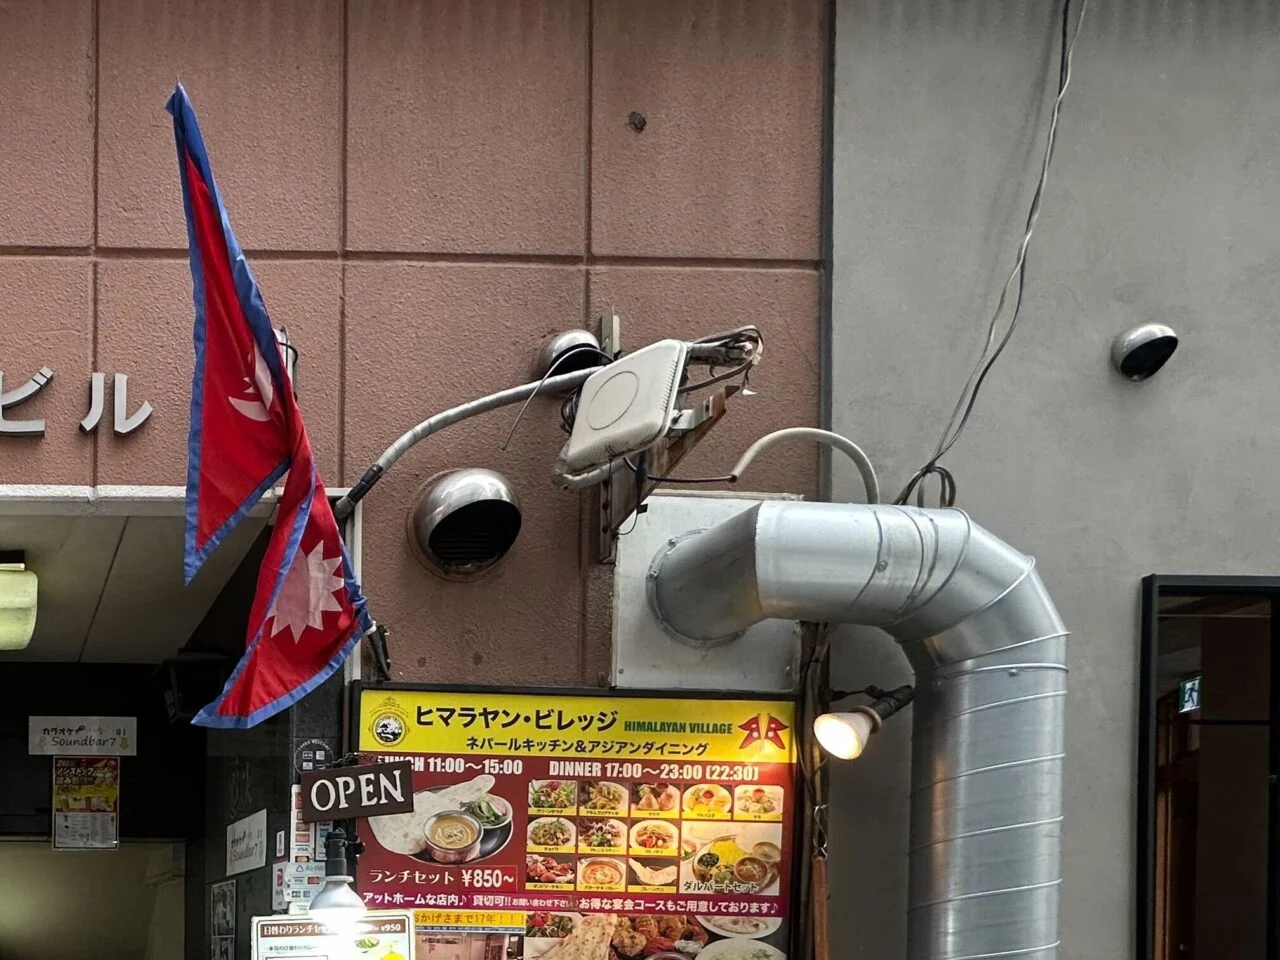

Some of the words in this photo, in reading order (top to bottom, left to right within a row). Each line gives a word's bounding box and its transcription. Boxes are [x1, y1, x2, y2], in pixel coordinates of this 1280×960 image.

[416, 705, 618, 732] ヒマラヤン・ビレッジ
[624, 719, 687, 735] HIMALAYAN
[689, 721, 733, 736] VILLAGE
[42, 727, 74, 736] カラオケ
[549, 761, 602, 778] DINNER
[310, 769, 405, 812] OPEN
[369, 870, 454, 885] ランチセット
[683, 881, 760, 894] ダルバートセット
